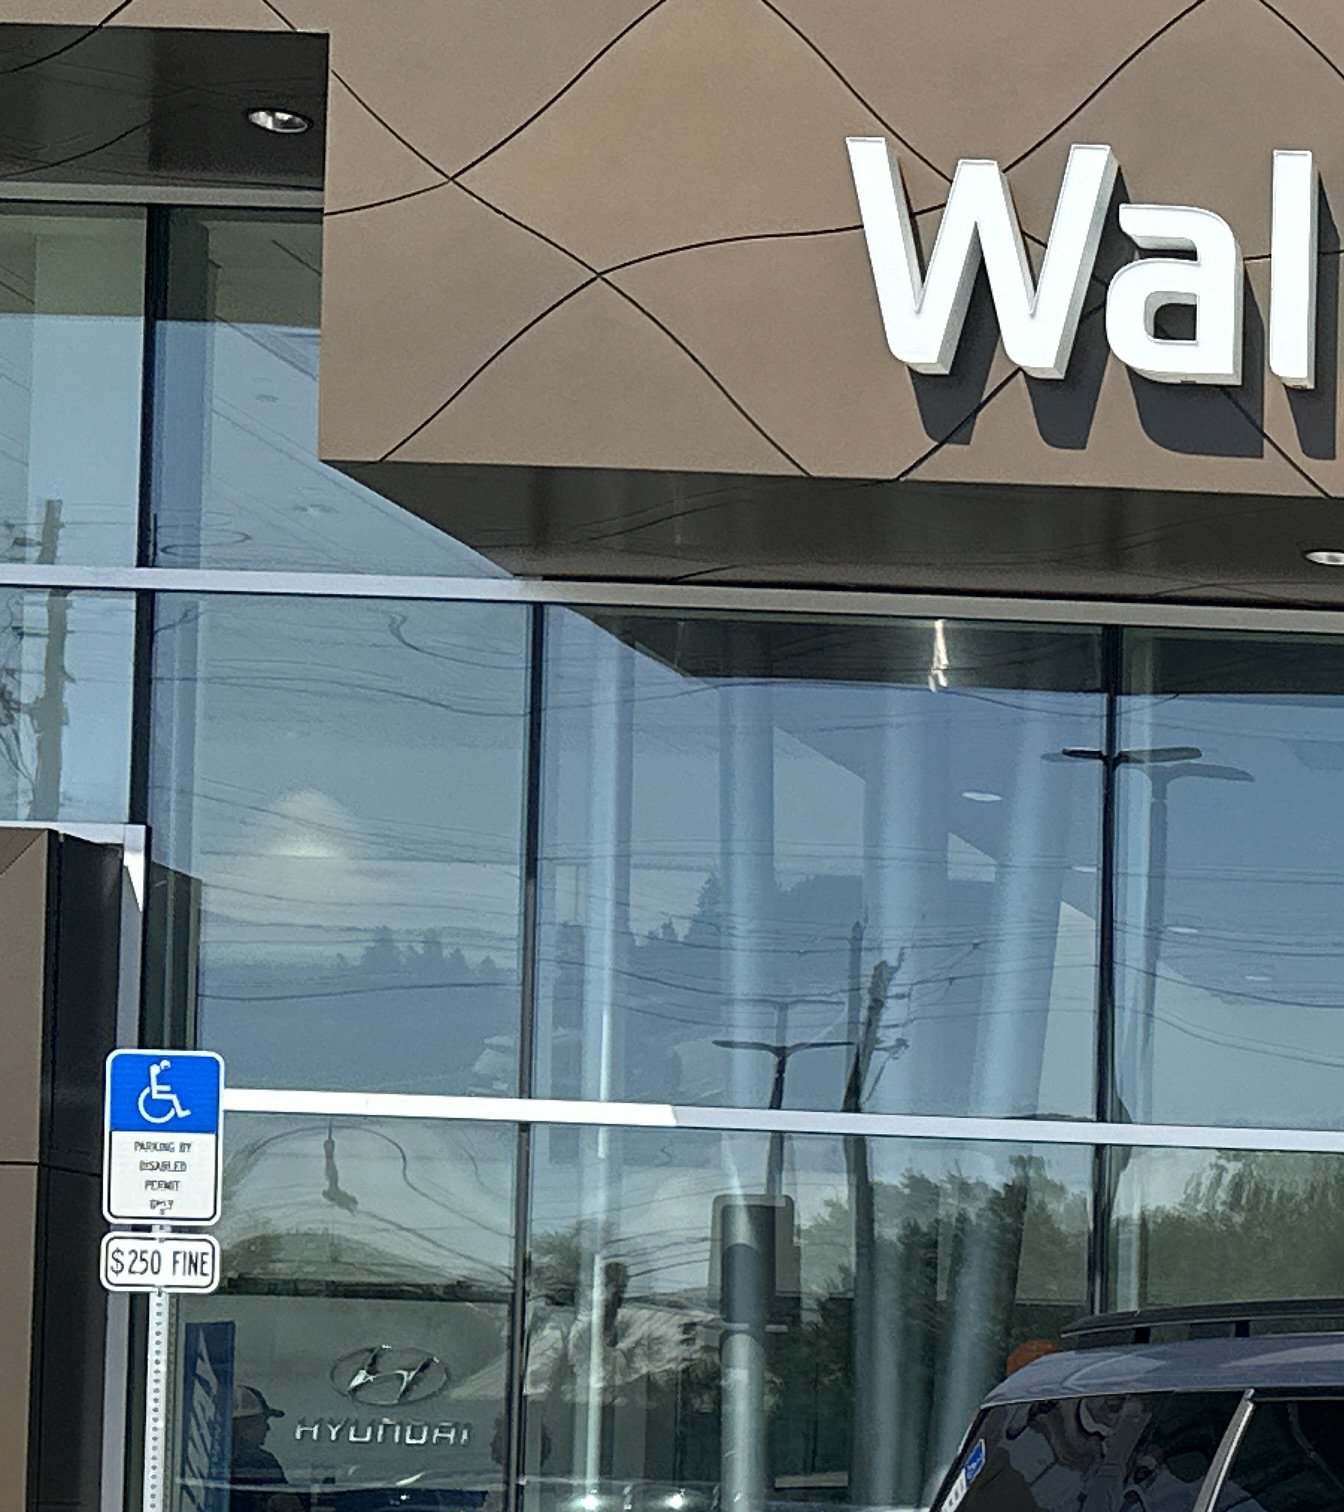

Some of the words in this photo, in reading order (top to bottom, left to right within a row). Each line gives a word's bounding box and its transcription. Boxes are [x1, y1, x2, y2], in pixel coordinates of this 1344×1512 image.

[134, 1141, 175, 1153] PARKING
[179, 1141, 192, 1153] BY
[139, 1160, 187, 1172] DISABLED
[144, 1180, 181, 1192] PERMIT
[150, 1199, 174, 1210] ONLY
[110, 1247, 162, 1277] $250
[172, 1250, 210, 1277] FINE
[294, 1416, 471, 1446] HYUNDAI
